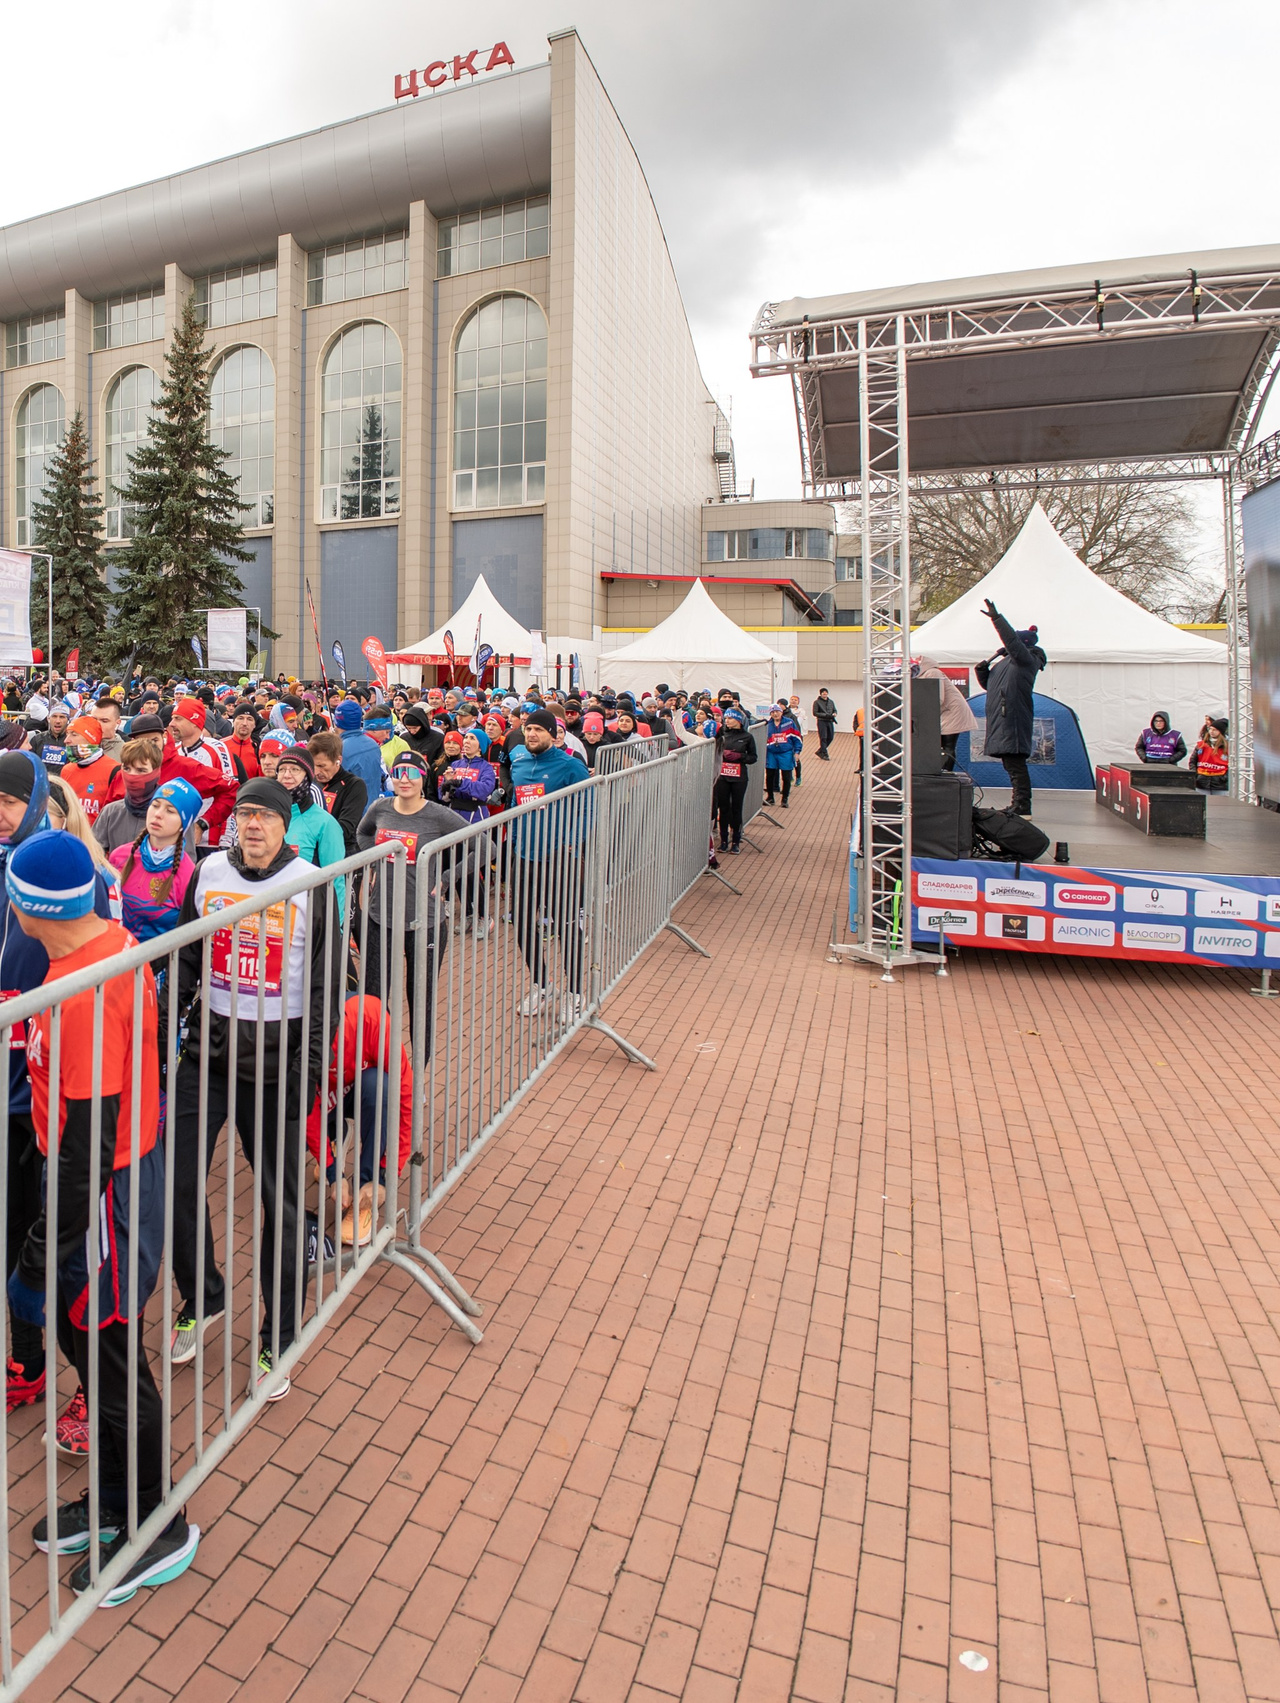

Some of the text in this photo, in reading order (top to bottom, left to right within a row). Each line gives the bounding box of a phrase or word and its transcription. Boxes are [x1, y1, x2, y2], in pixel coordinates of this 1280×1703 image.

[395, 41, 515, 98] ЦСКА
[269, 730, 296, 746] RUN
[1102, 777, 1107, 797] 2
[1117, 780, 1122, 802] 1
[1136, 797, 1141, 820] 3
[1058, 925, 1111, 938] AIRONIC
[1127, 930, 1175, 940] ВЕЛОСПОРТ
[1198, 935, 1252, 948] INVITRO
